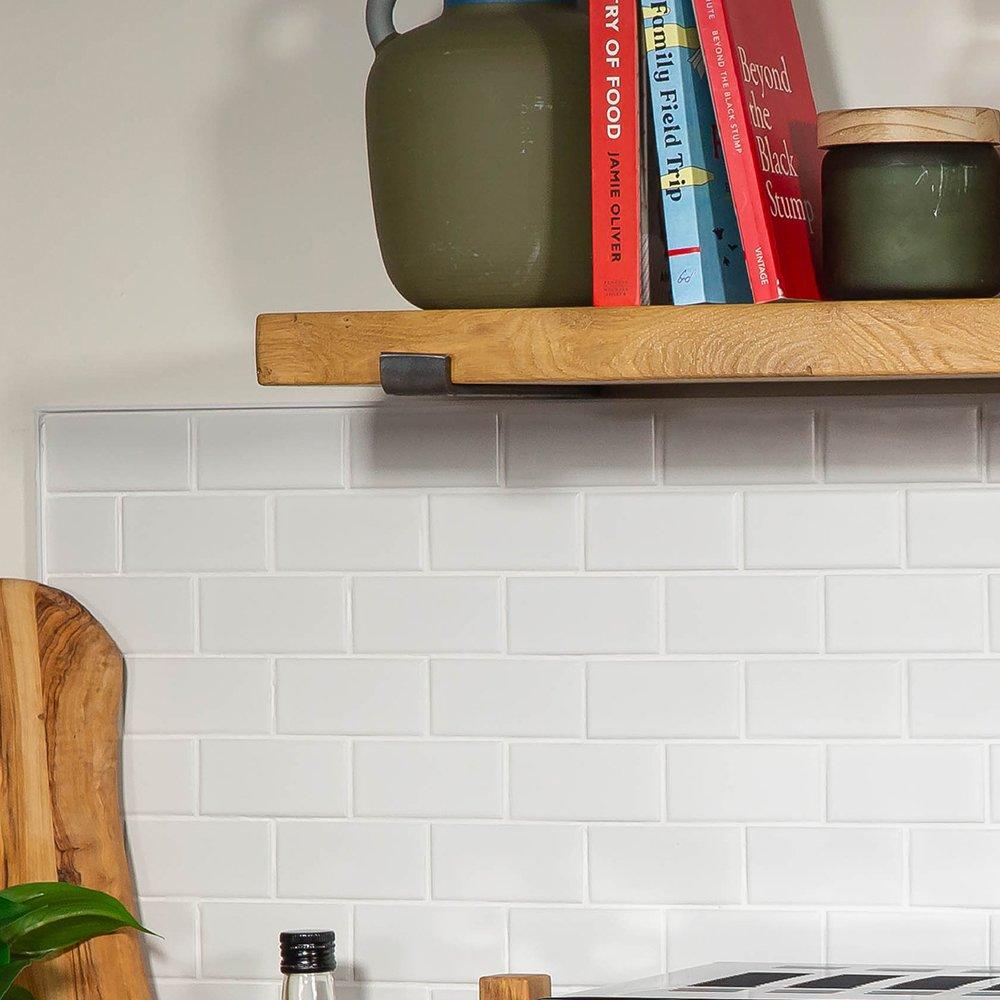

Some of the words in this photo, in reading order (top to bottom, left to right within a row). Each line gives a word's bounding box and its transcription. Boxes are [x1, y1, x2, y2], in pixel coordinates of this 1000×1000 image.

[605, 0, 619, 32] RY
[605, 39, 619, 68] OF
[650, 2, 674, 82] Family
[712, 29, 725, 68] BEYOND
[720, 70, 730, 89] THE
[738, 46, 792, 98] Beyond
[606, 76, 621, 139] FOOD
[660, 89, 682, 148] Field
[724, 91, 735, 120] BLACK
[749, 91, 773, 130] the
[730, 123, 742, 154] STUMP
[756, 135, 798, 177] Black
[607, 152, 621, 197] JAMIE
[666, 153, 686, 202] Trip
[766, 180, 815, 234] Stump
[610, 204, 621, 262] OLIVER
[754, 247, 768, 285] VINTAGE
